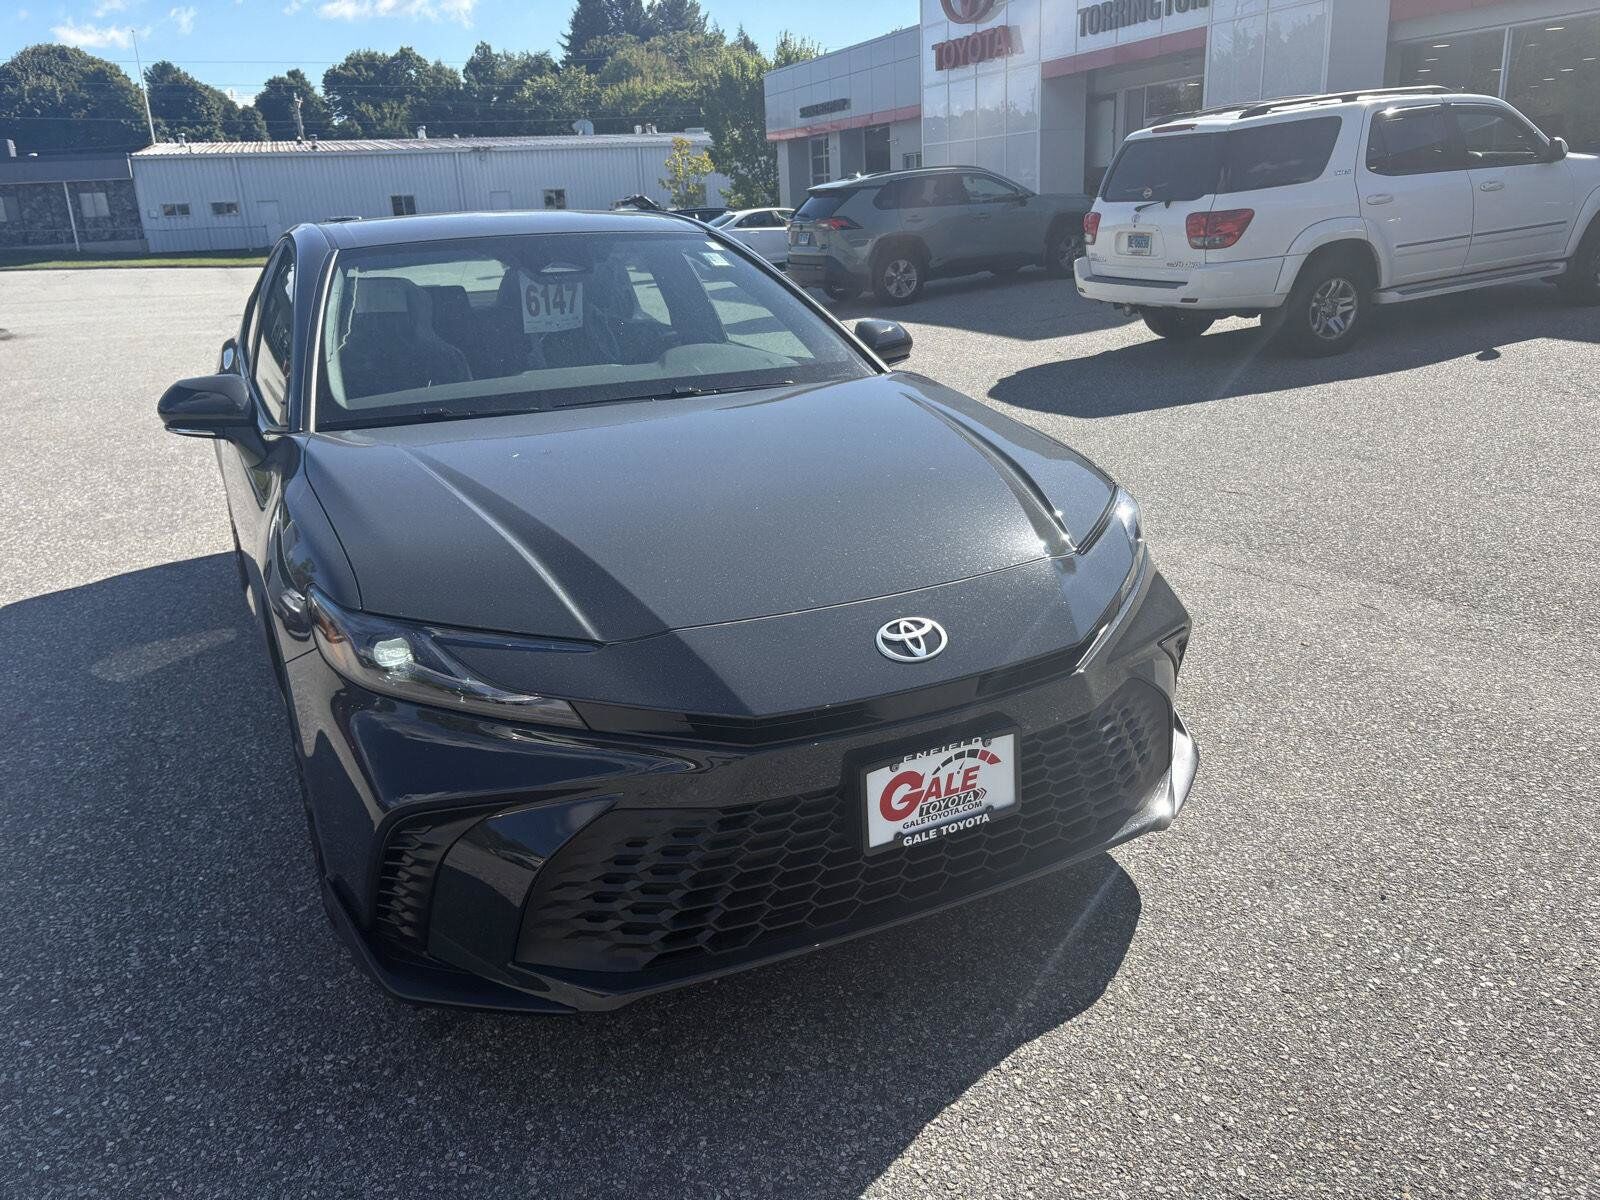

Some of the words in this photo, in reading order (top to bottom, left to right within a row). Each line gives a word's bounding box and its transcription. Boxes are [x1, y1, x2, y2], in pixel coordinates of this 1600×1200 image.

[932, 25, 1008, 71] TOYOTA
[525, 283, 578, 317] 6147
[904, 737, 981, 763] ENFIELD
[879, 765, 981, 822] GALE
[921, 791, 975, 816] TOYOTA
[902, 801, 982, 830] GALETOYOTA.COM
[902, 829, 937, 847] GALE
[940, 813, 991, 836] TOYOTA
